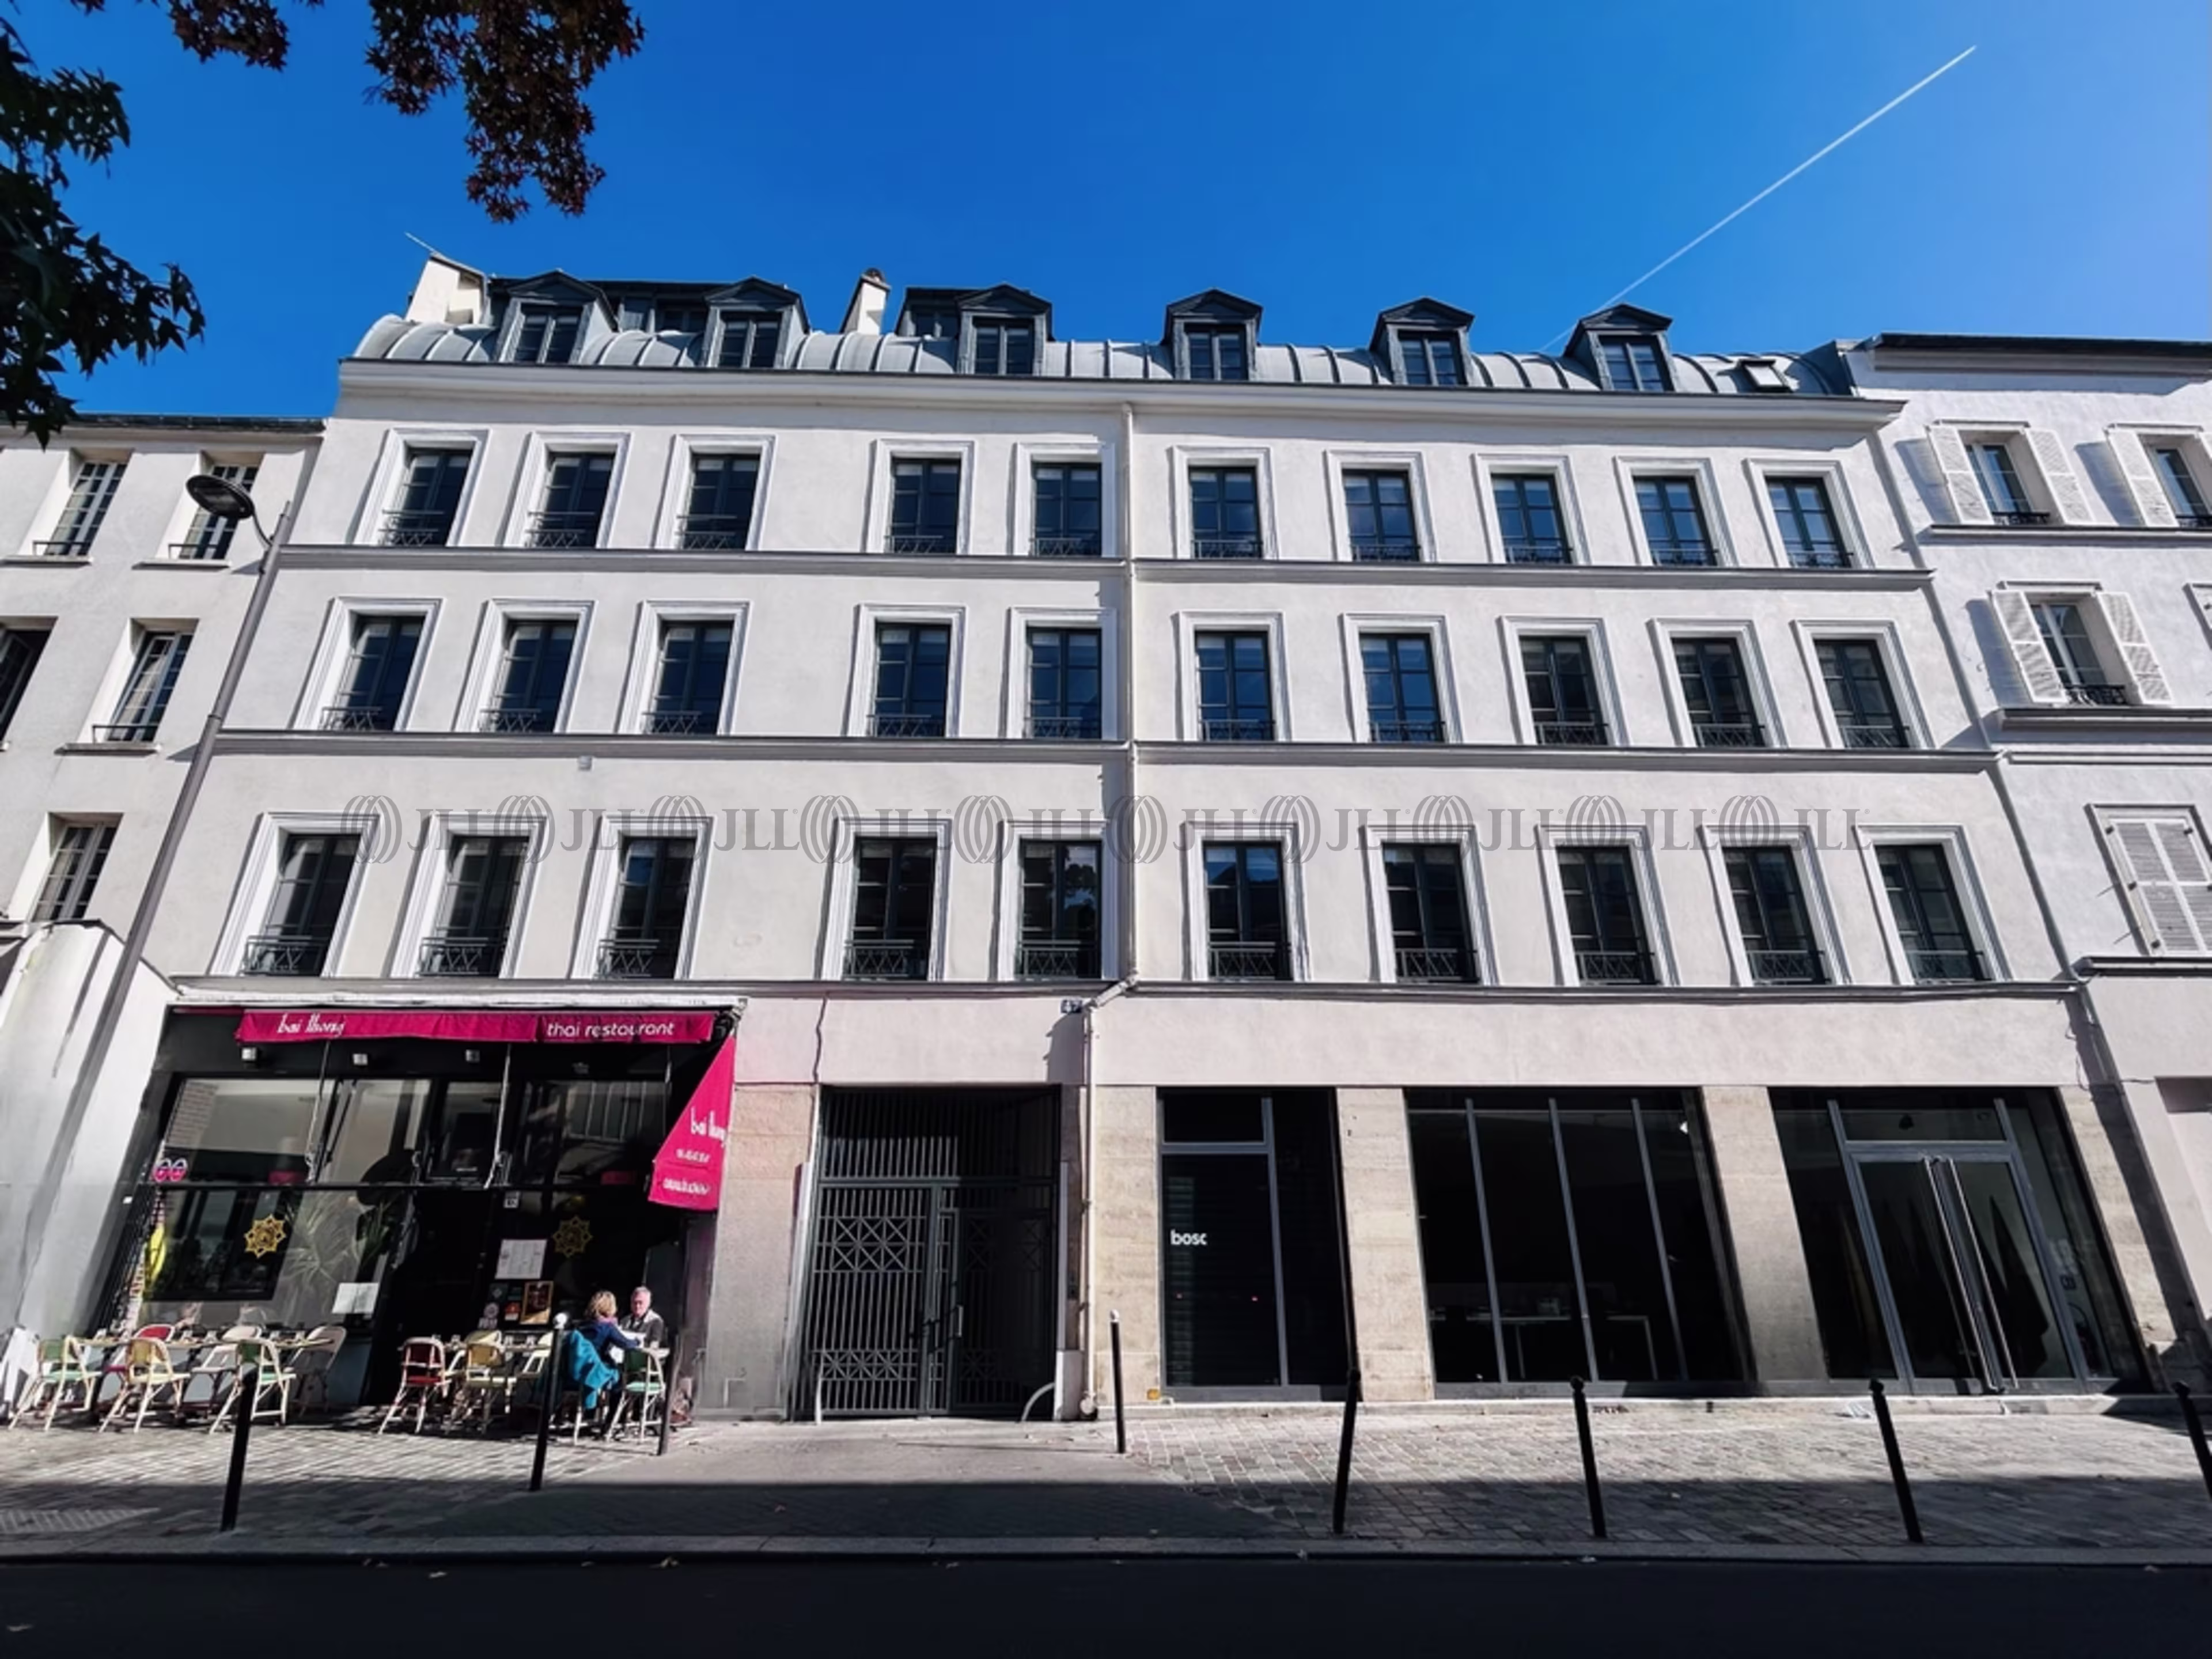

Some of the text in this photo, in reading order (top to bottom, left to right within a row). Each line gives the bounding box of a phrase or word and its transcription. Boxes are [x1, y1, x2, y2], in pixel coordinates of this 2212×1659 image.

[276, 1013, 303, 1033] bai
[547, 1022, 674, 1038] thai restaurant
[1171, 1229, 1207, 1245] bosc
